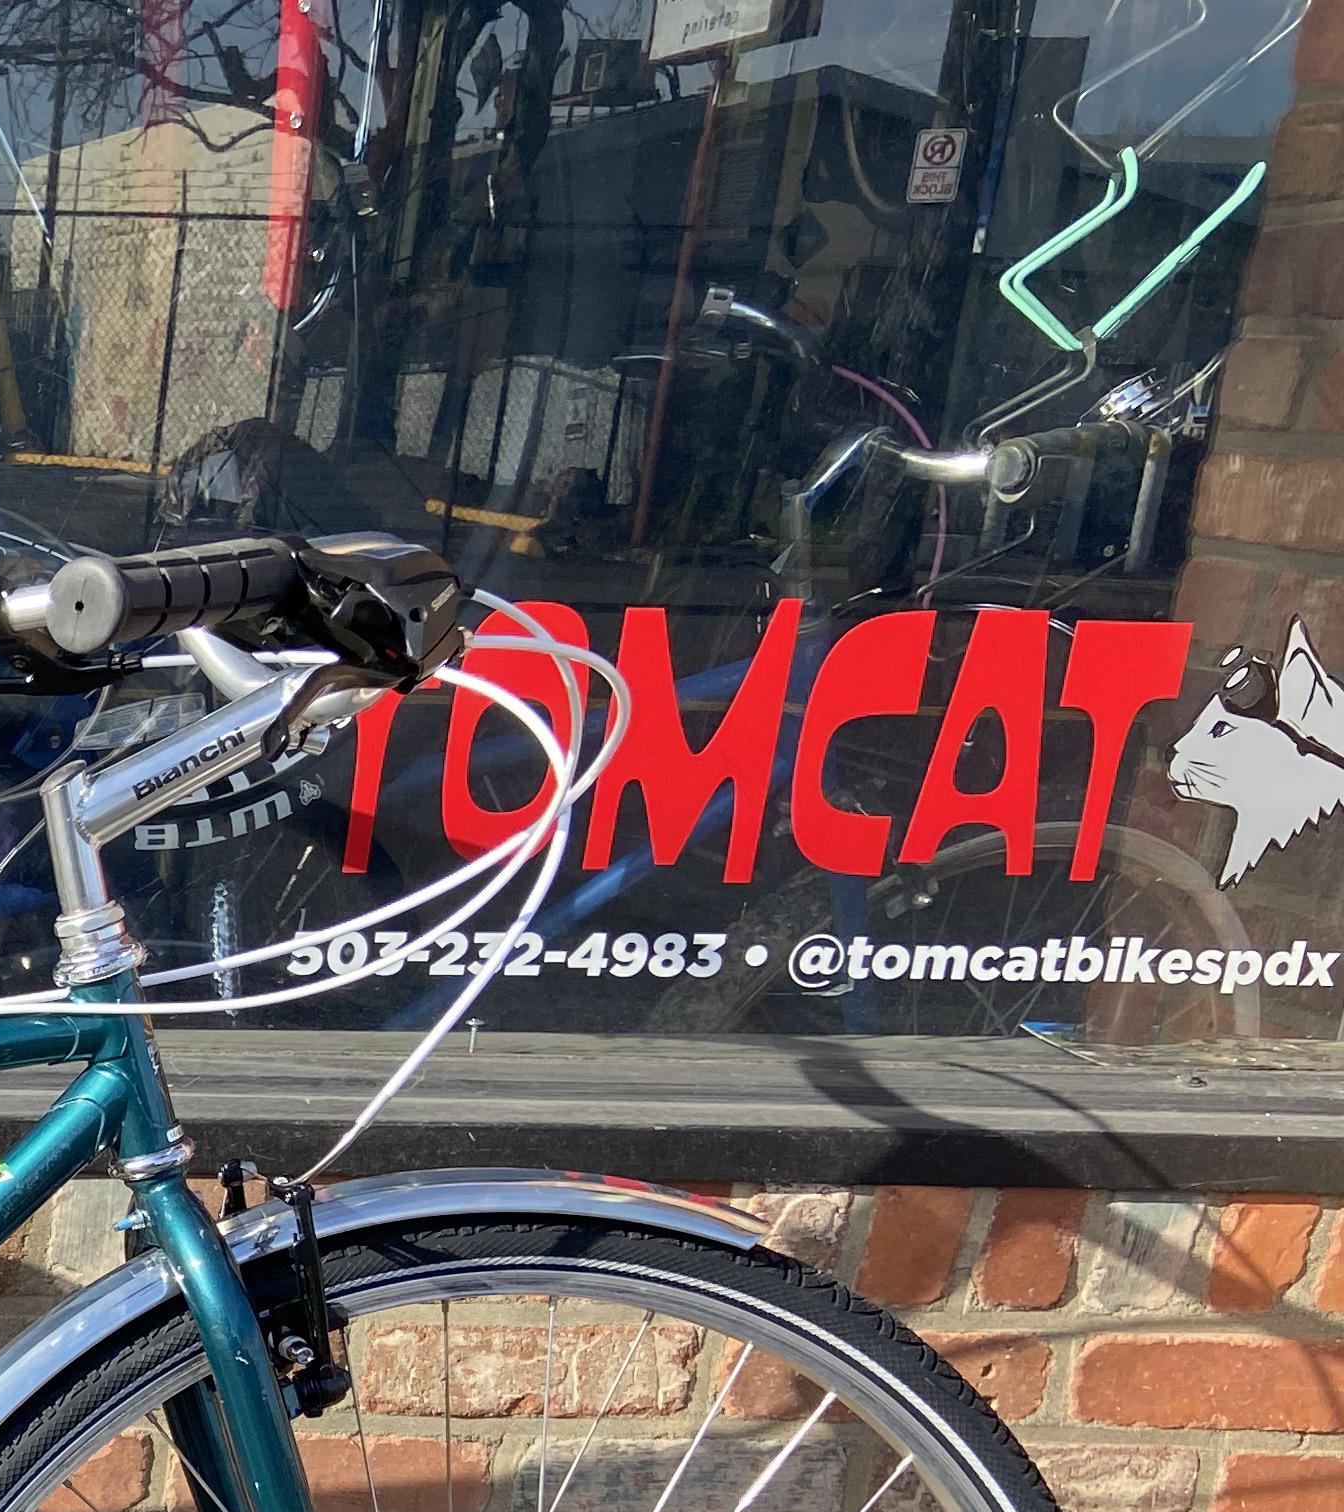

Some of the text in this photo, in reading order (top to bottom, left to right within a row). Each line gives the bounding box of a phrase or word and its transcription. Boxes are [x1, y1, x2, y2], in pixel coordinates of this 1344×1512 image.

[132, 727, 246, 800] Bianchi
[341, 598, 1195, 884] TOMCAT
[134, 790, 294, 851] WTB
[287, 931, 1341, 993] 503-232-4983 @tomcatbikespdx
